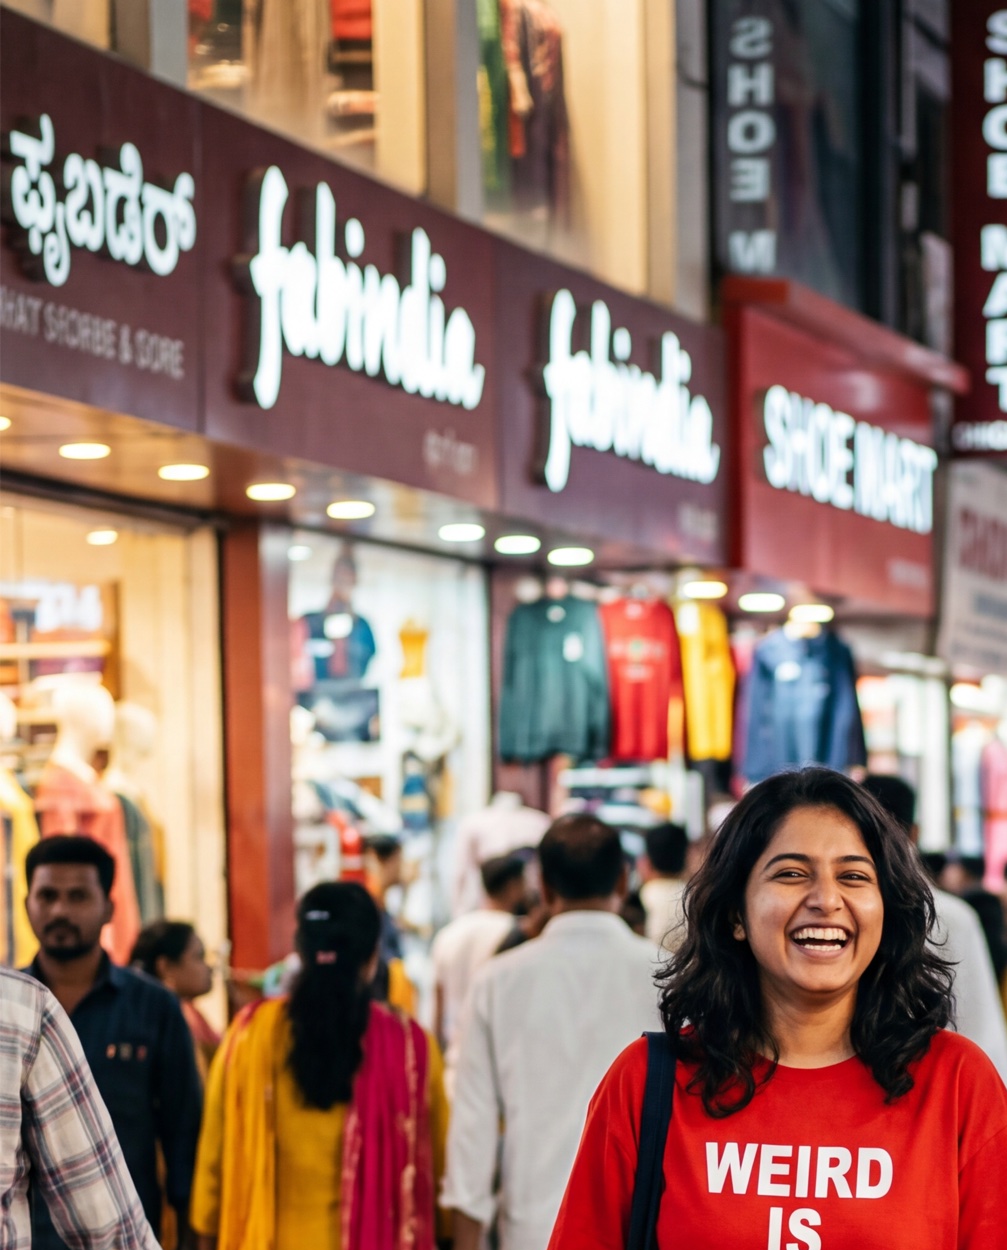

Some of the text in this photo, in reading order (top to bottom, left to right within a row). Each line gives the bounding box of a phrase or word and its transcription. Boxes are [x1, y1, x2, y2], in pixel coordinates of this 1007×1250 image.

[763, 384, 938, 534] SHOE MART
[705, 1141, 894, 1199] WEIRD
